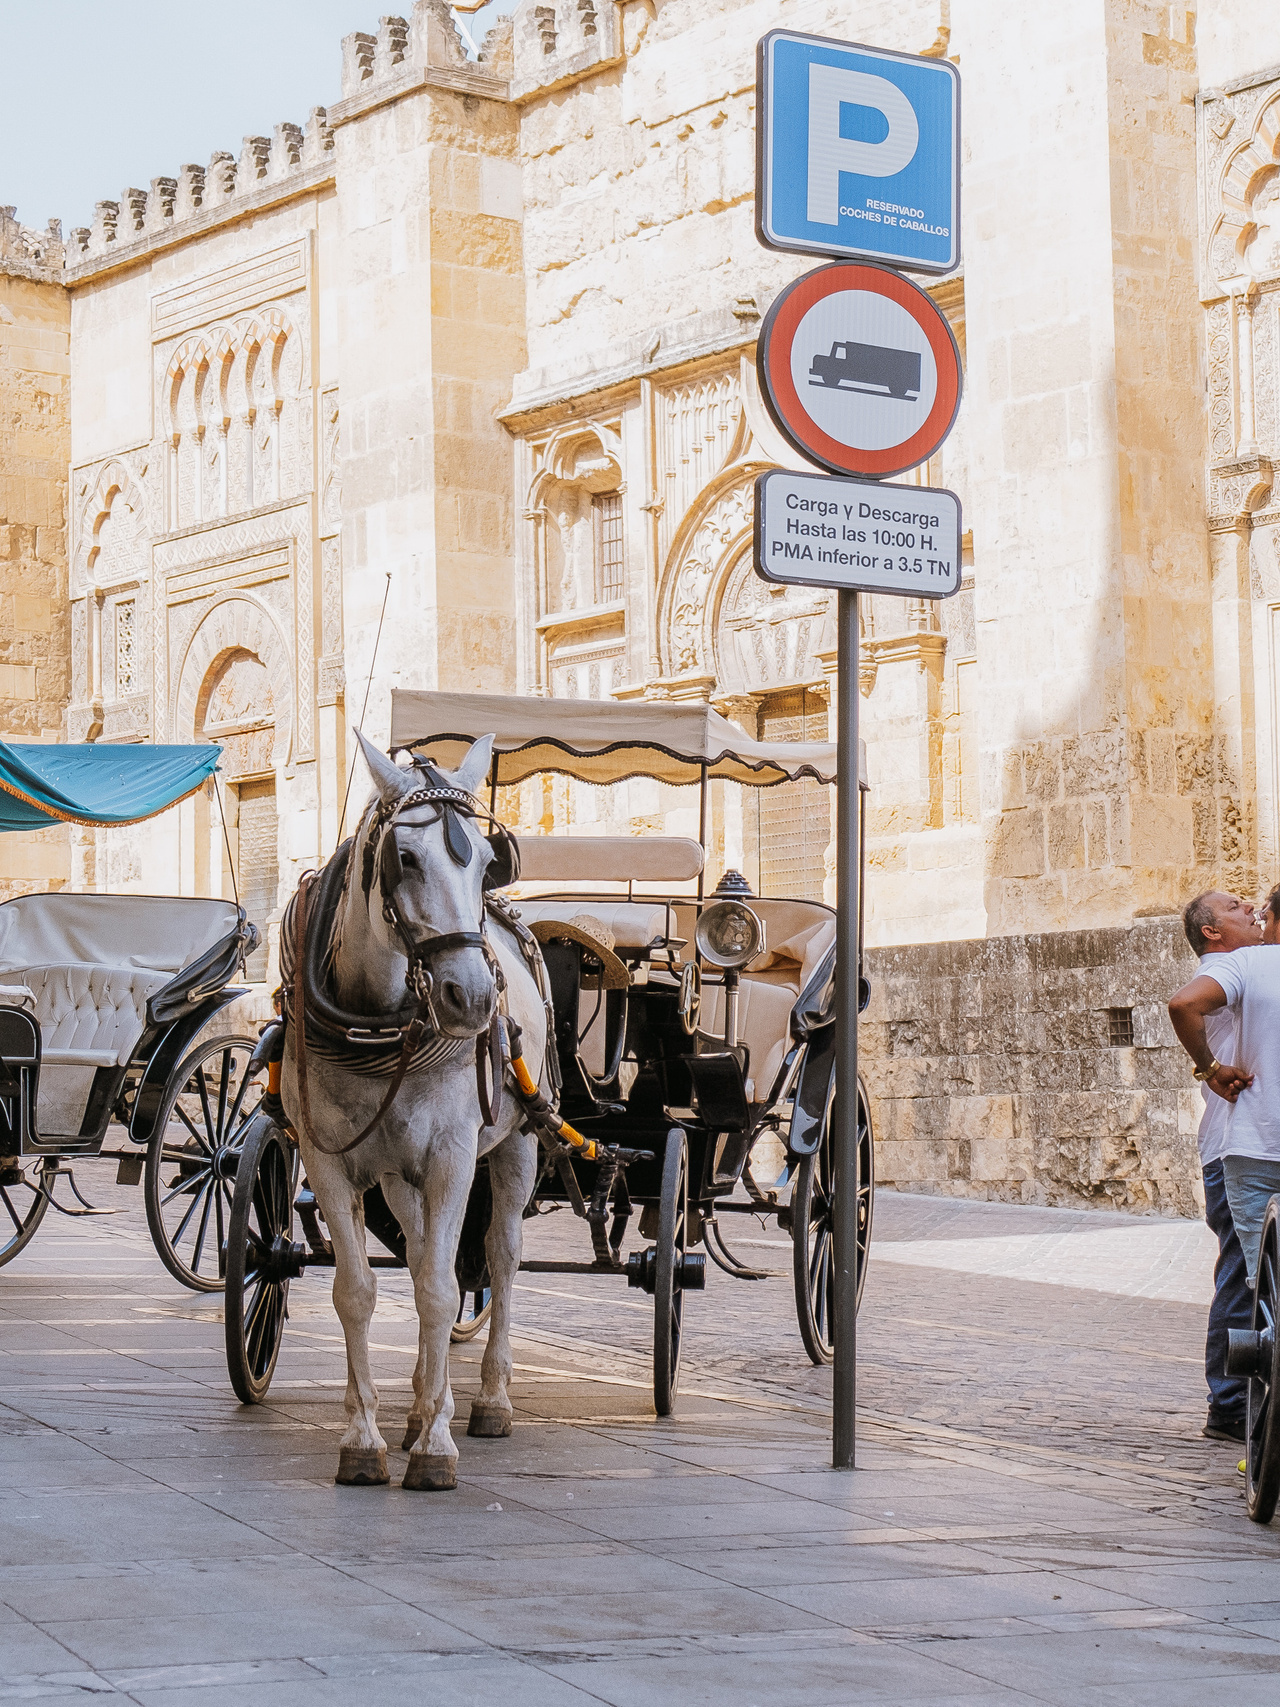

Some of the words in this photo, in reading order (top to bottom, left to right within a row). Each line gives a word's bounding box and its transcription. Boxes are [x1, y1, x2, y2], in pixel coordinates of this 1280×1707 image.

[807, 62, 919, 226] P
[839, 206, 882, 223] COCHES
[883, 215, 897, 226] DE
[899, 218, 950, 237] CABALLOS
[866, 198, 925, 219] RESERVADO
[786, 493, 838, 517] Carga
[843, 504, 853, 520] y
[859, 502, 939, 529] Descarga
[786, 517, 836, 539] Hasta
[842, 525, 866, 542] las
[872, 528, 915, 548] 10:00
[920, 534, 938, 551] H.
[771, 540, 813, 561] PMA
[818, 546, 879, 568] inferior
[883, 558, 893, 570] a
[898, 556, 922, 573] 3.5
[927, 559, 950, 577] TN
